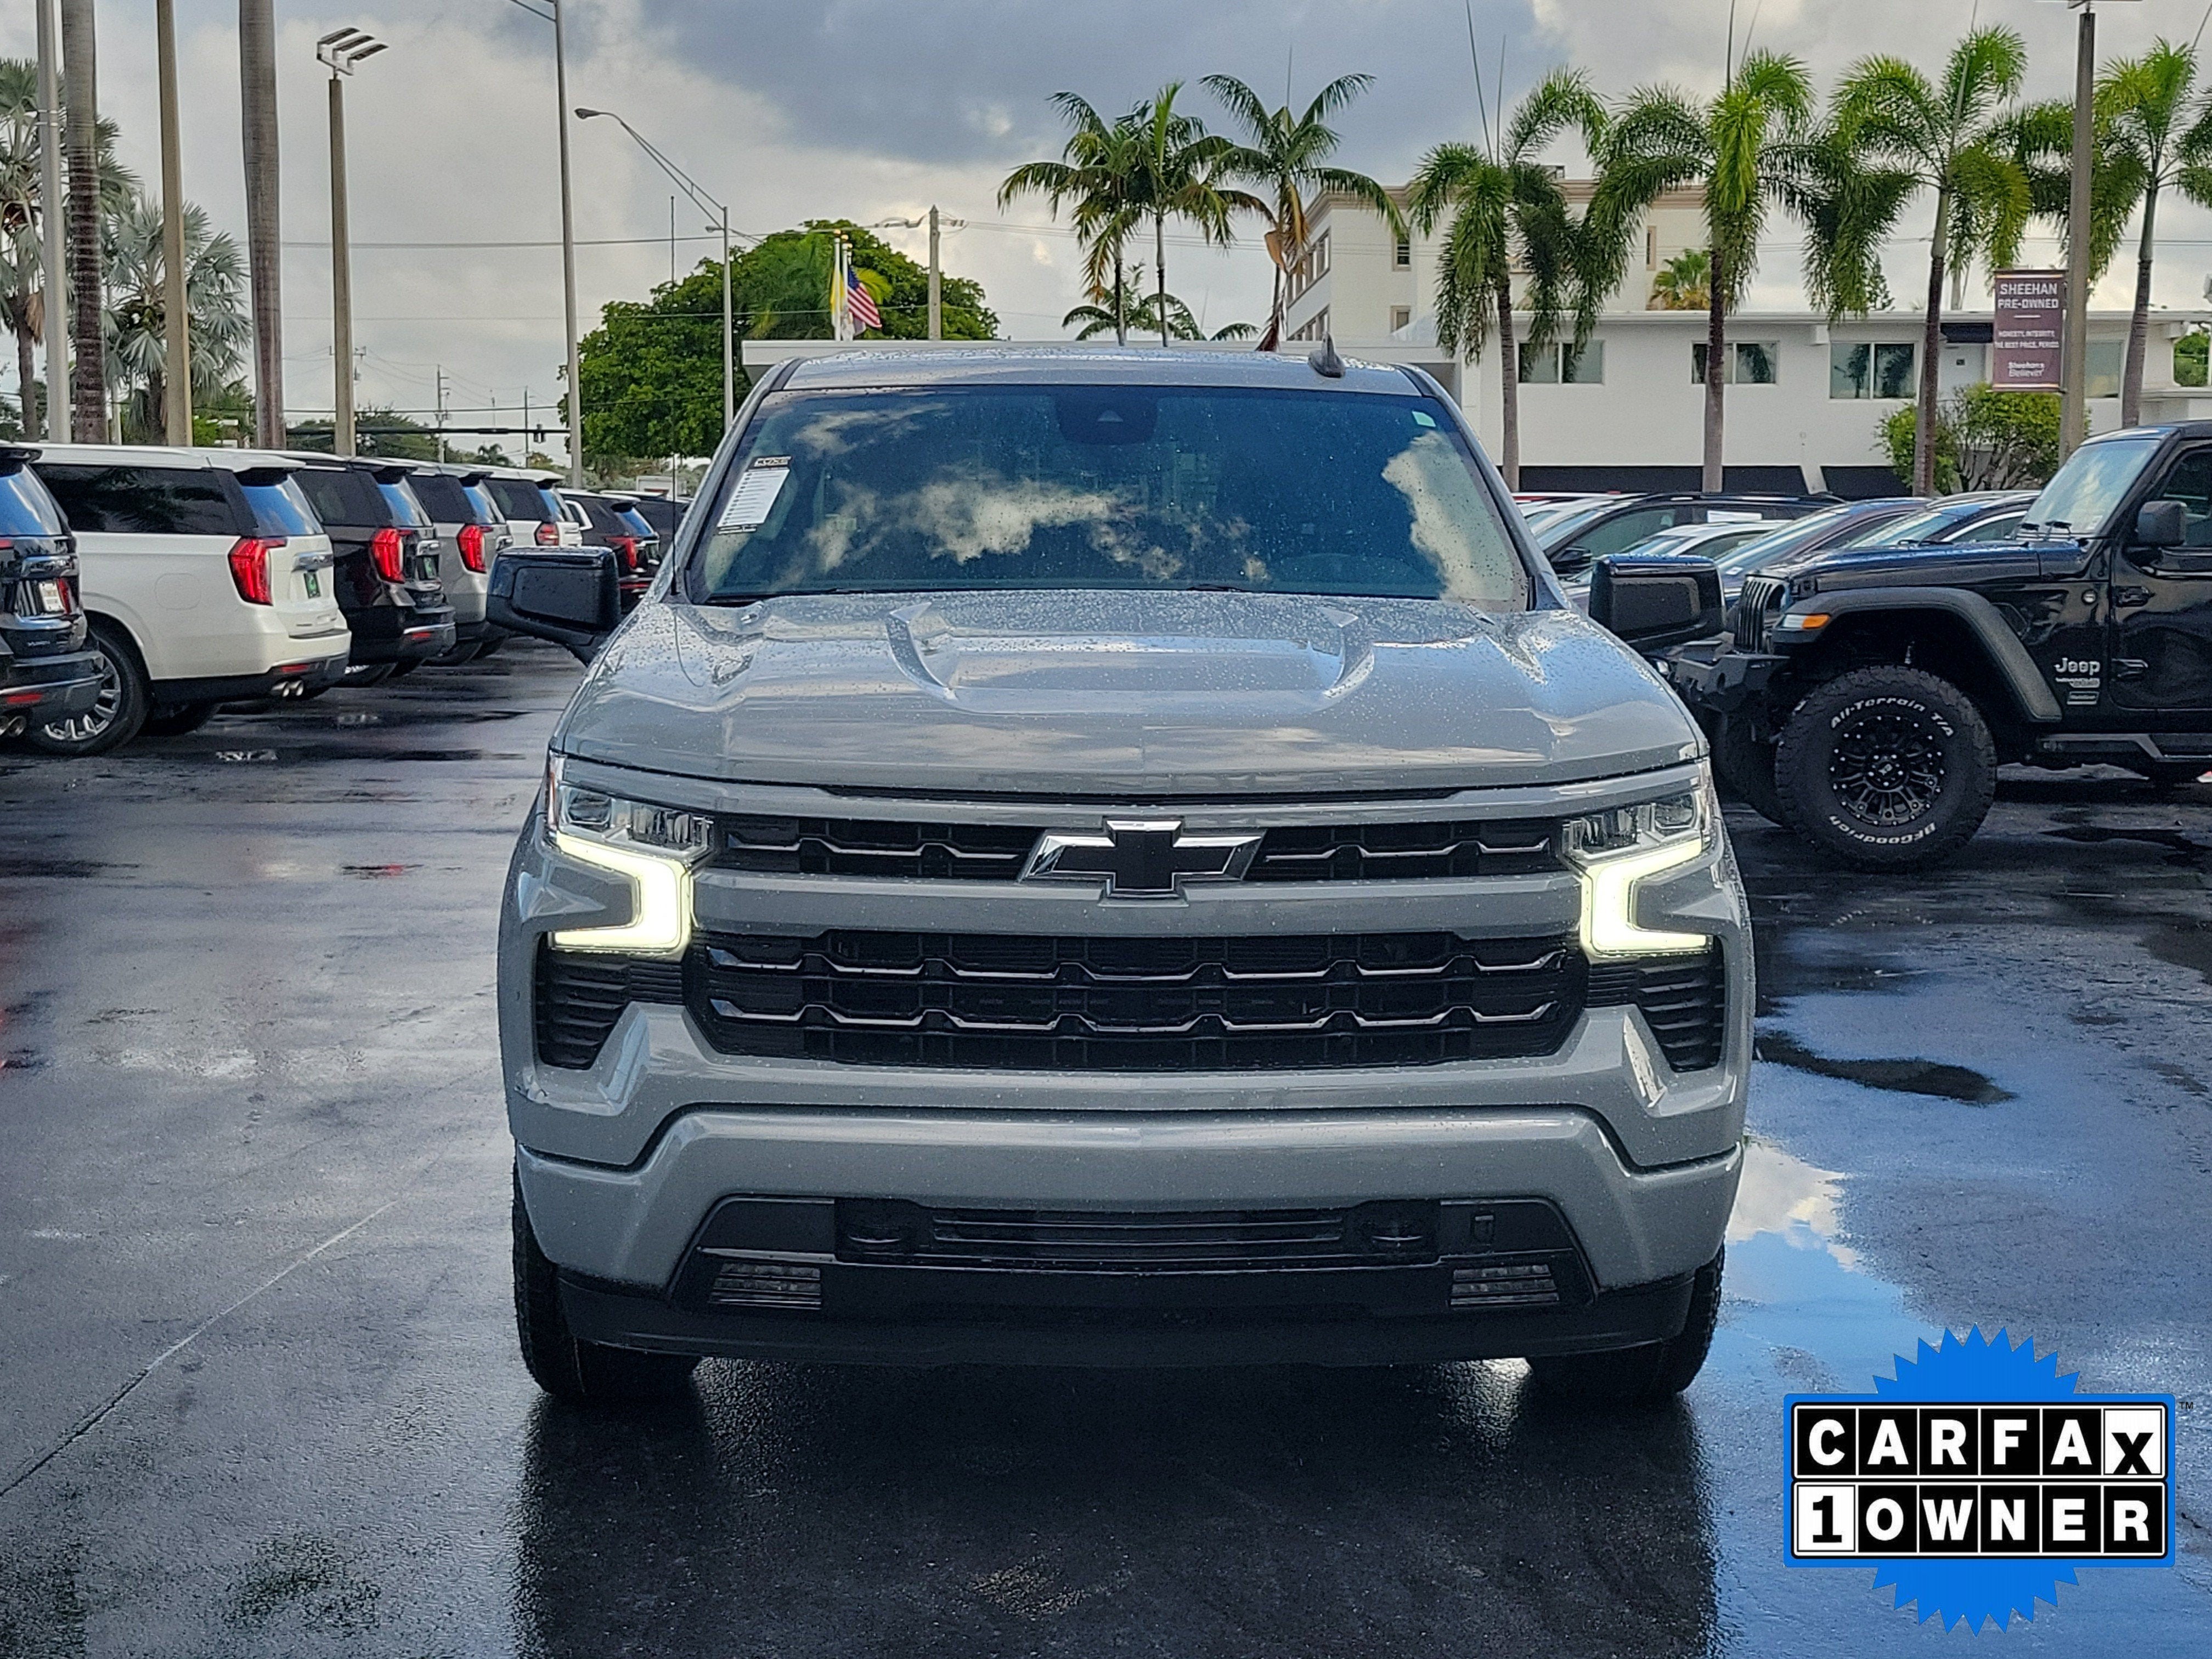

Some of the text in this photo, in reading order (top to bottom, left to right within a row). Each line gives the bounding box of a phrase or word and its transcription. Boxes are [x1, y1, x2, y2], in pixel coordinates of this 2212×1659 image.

[1999, 283, 2057, 295] SHEEHAN
[1997, 298, 2059, 309] PRE-OWNED
[2053, 657, 2101, 676] Jeep
[1831, 697, 1954, 737] All-Terrain T/A
[1829, 815, 1936, 844] BFGoodrich
